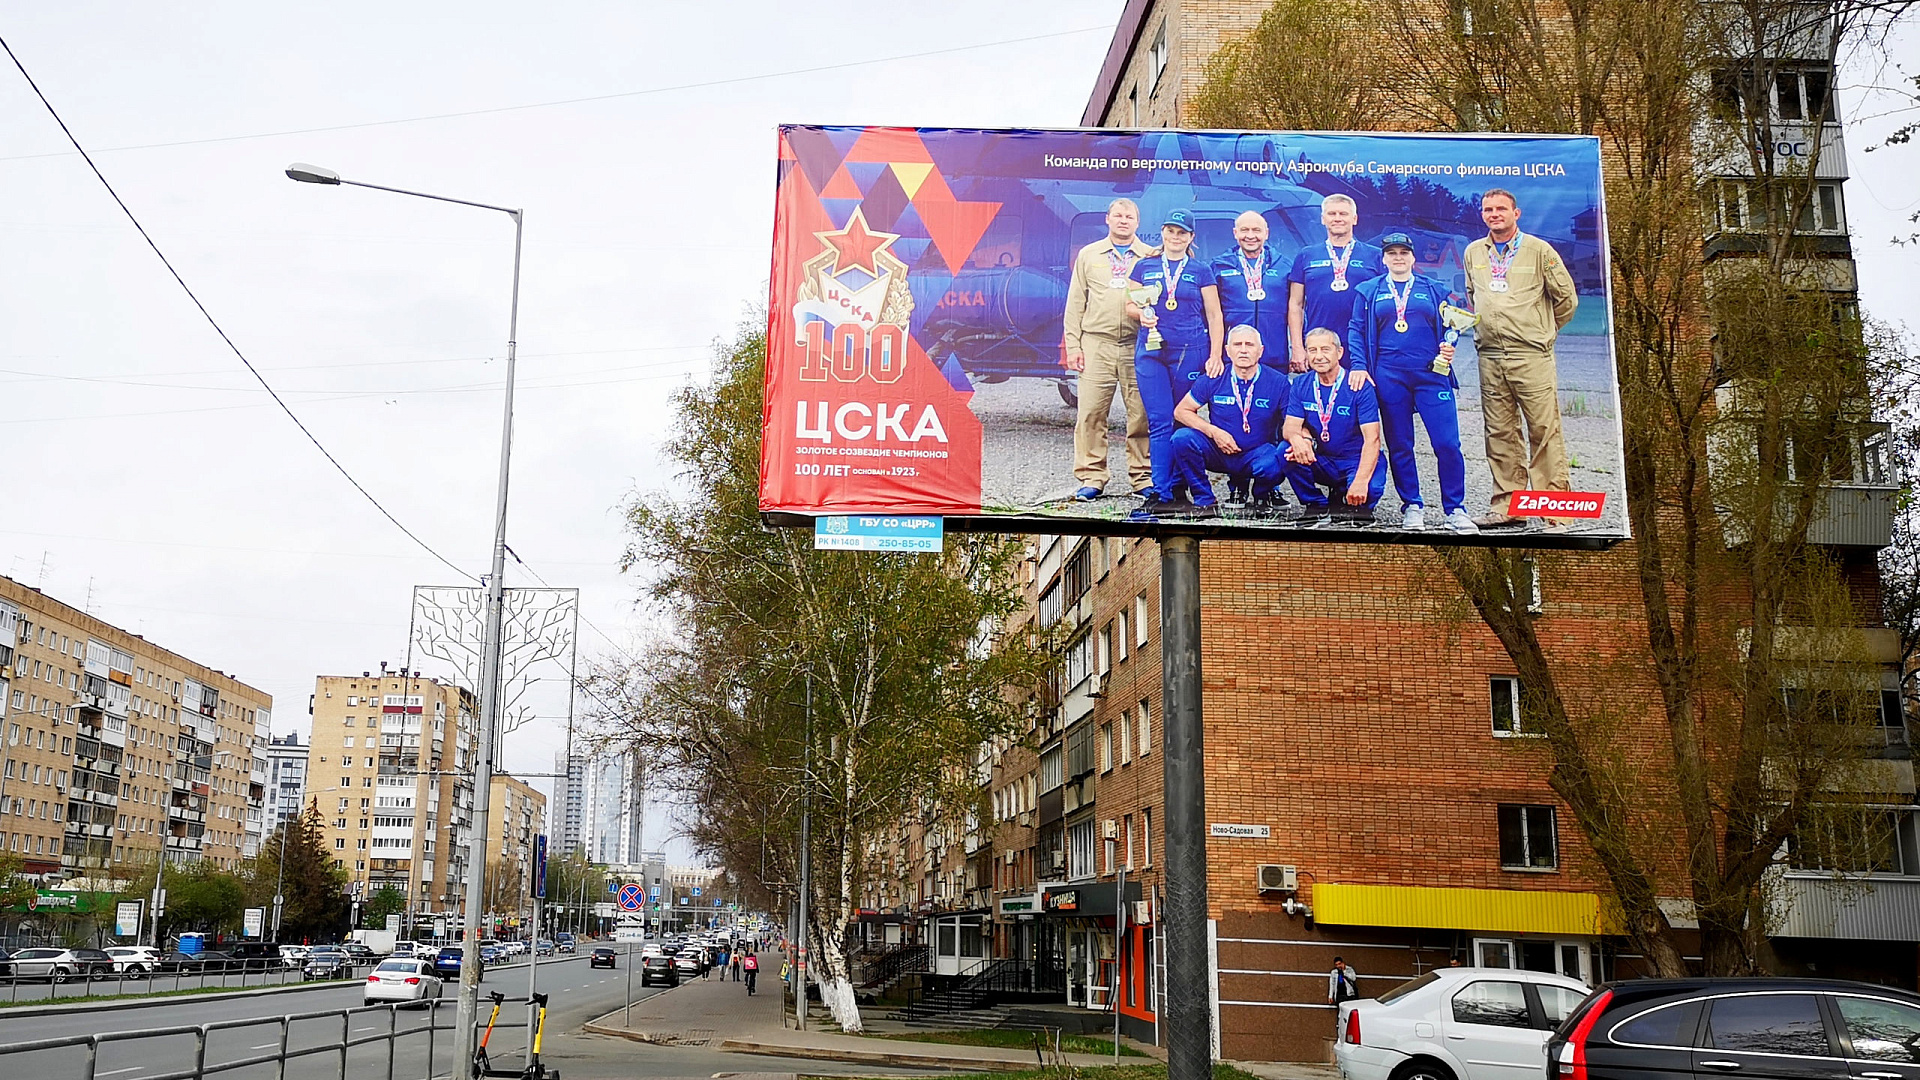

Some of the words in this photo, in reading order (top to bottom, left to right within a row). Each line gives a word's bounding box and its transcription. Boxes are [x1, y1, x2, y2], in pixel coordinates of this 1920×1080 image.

[1044, 154, 1108, 170] Команда
[1111, 158, 1129, 169] по
[1132, 158, 1231, 173] вертолетному
[1235, 160, 1284, 175] спорту
[1287, 160, 1365, 176] Аэроклуба
[1367, 160, 1453, 177] Самарского
[1456, 162, 1521, 178] филиала
[1524, 163, 1566, 178] ЦСКА
[828, 289, 874, 322] ЦСКА
[799, 321, 904, 384] 100
[795, 400, 949, 443] ЦСКА
[795, 446, 838, 456] ЗОЛОТОЕ
[839, 447, 891, 457] СОЗВЕЗДИЕ
[892, 449, 949, 459] ЧЕМПИОНОВ
[794, 463, 821, 475] 100
[823, 465, 851, 477] ЛЕТ
[852, 468, 886, 476] ОСНОВАН
[891, 466, 915, 477] 1923
[859, 518, 881, 527] ГБУ
[882, 518, 899, 528] СО
[878, 539, 932, 548] 250-85-05
[1212, 826, 1254, 836] Ново-Садовая
[1260, 827, 1269, 835] 25
